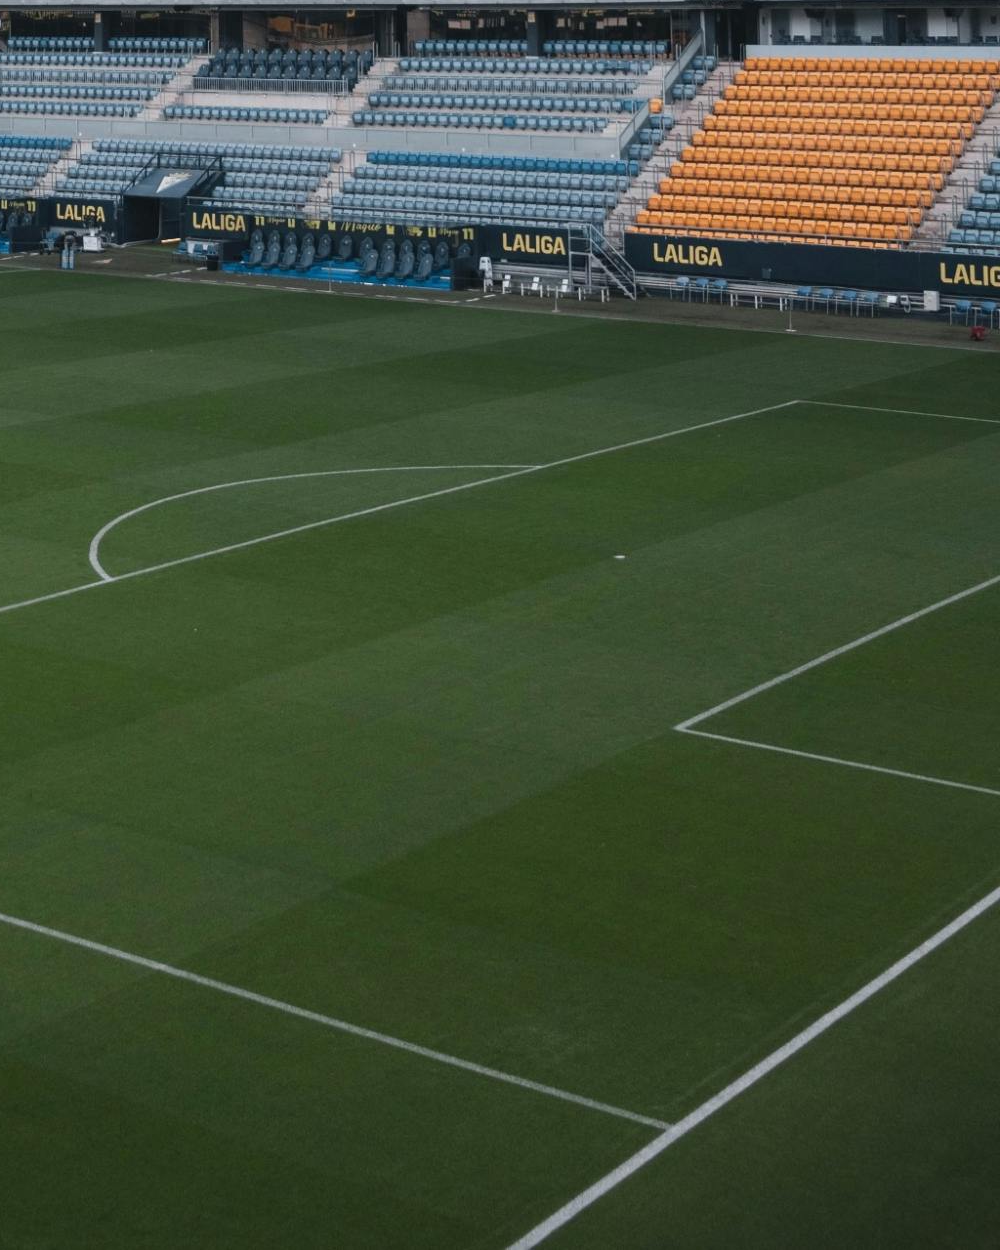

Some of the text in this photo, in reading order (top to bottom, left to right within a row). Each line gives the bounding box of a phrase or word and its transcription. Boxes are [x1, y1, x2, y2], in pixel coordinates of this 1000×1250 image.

[192, 212, 246, 231] LALIGA
[502, 232, 566, 255] LALIGA
[653, 242, 723, 267] LALIGA
[940, 262, 1000, 287] LALIG
